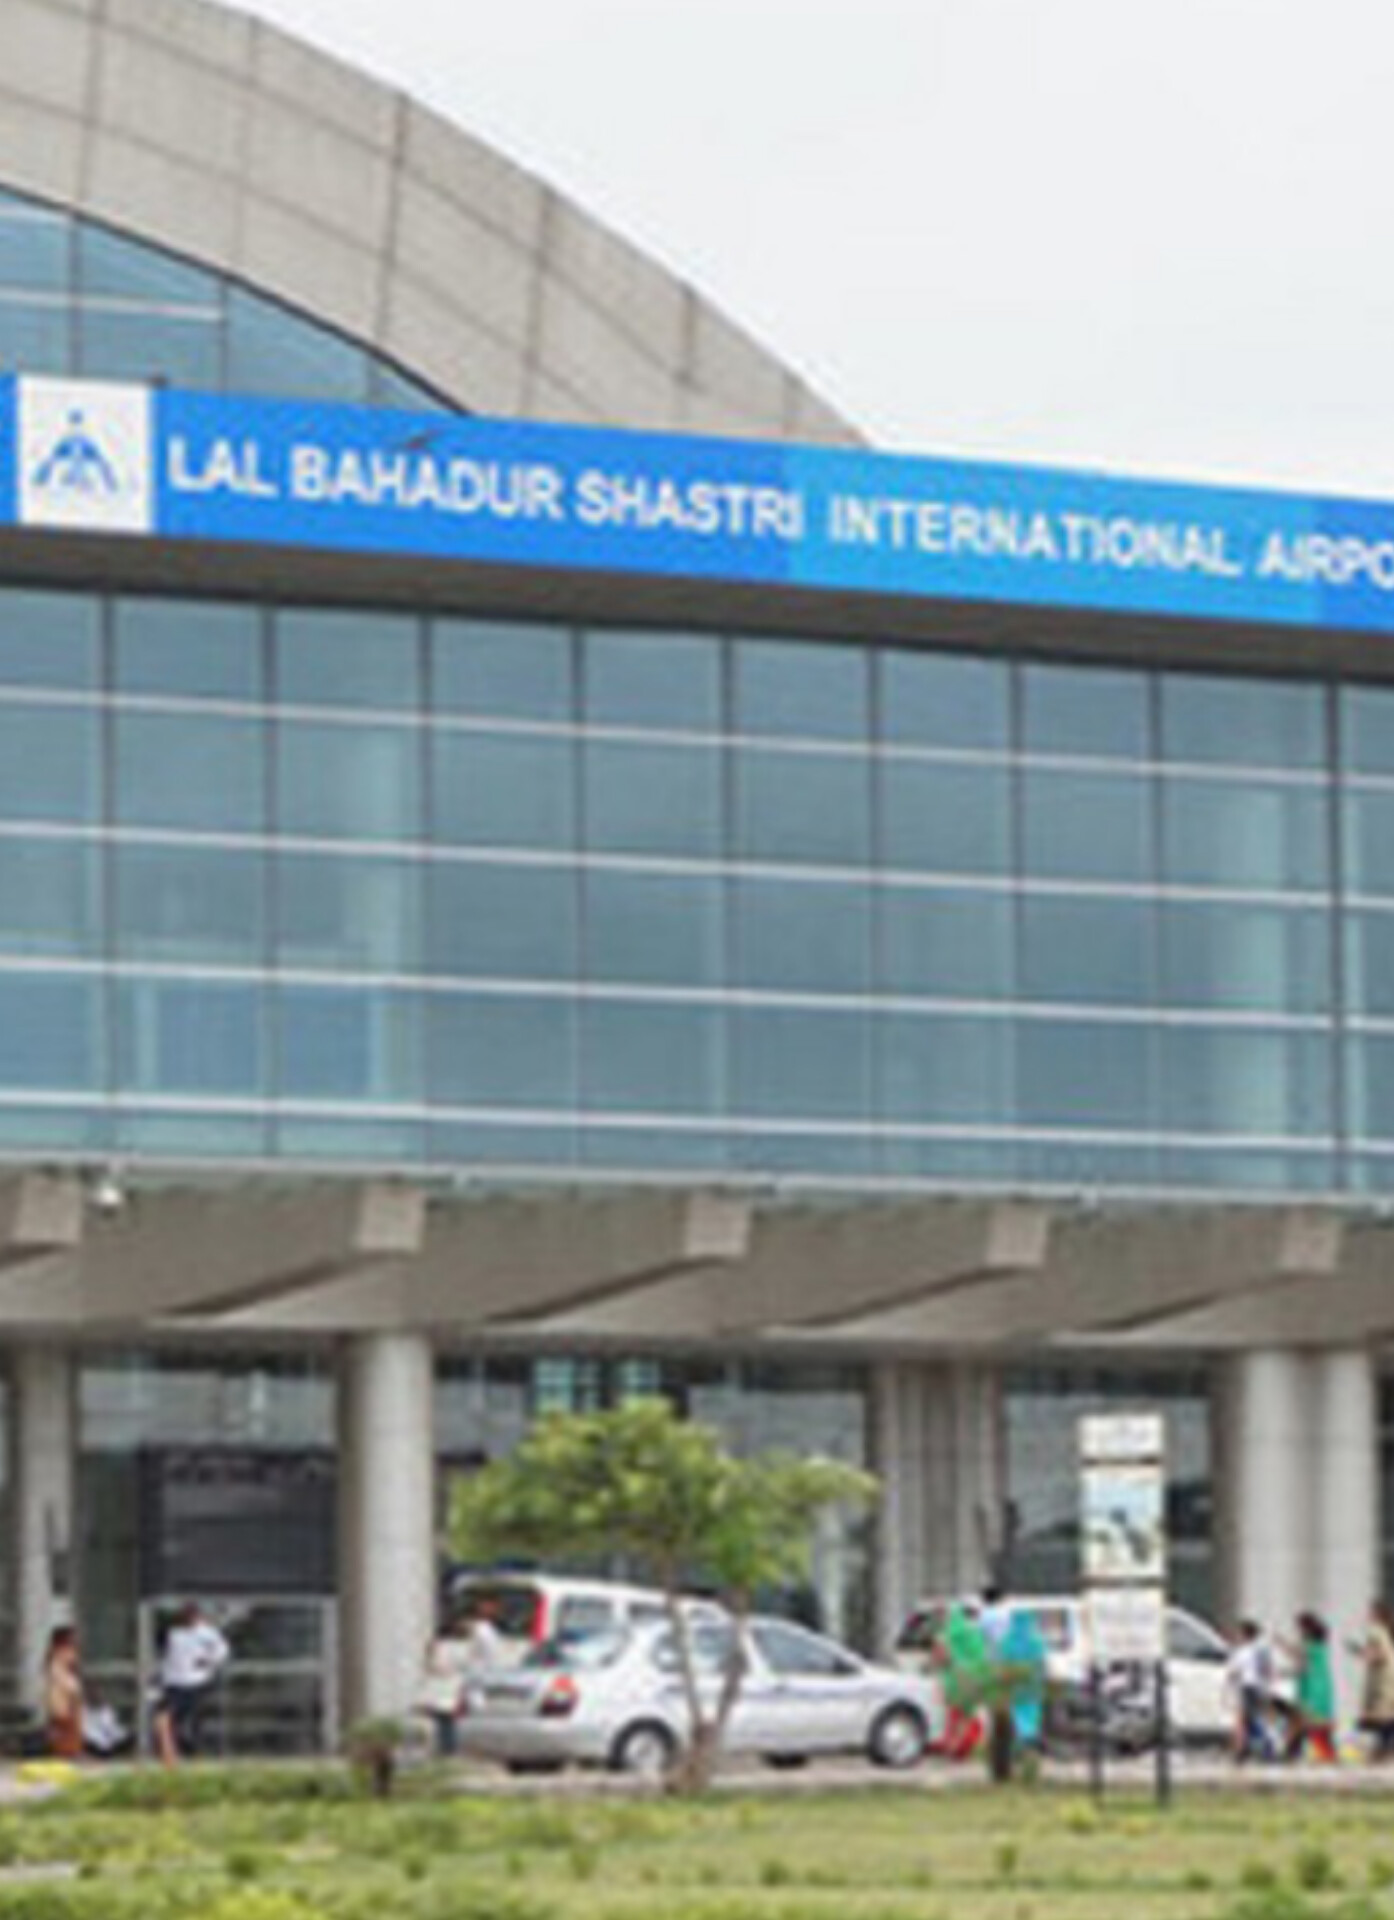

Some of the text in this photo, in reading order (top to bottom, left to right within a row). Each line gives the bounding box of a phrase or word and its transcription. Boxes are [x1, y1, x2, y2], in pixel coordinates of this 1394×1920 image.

[168, 437, 276, 498] LAL
[291, 447, 564, 520] BAHADUR
[577, 470, 801, 539] SHASTRI
[829, 497, 1240, 576] INTERNATIONAL
